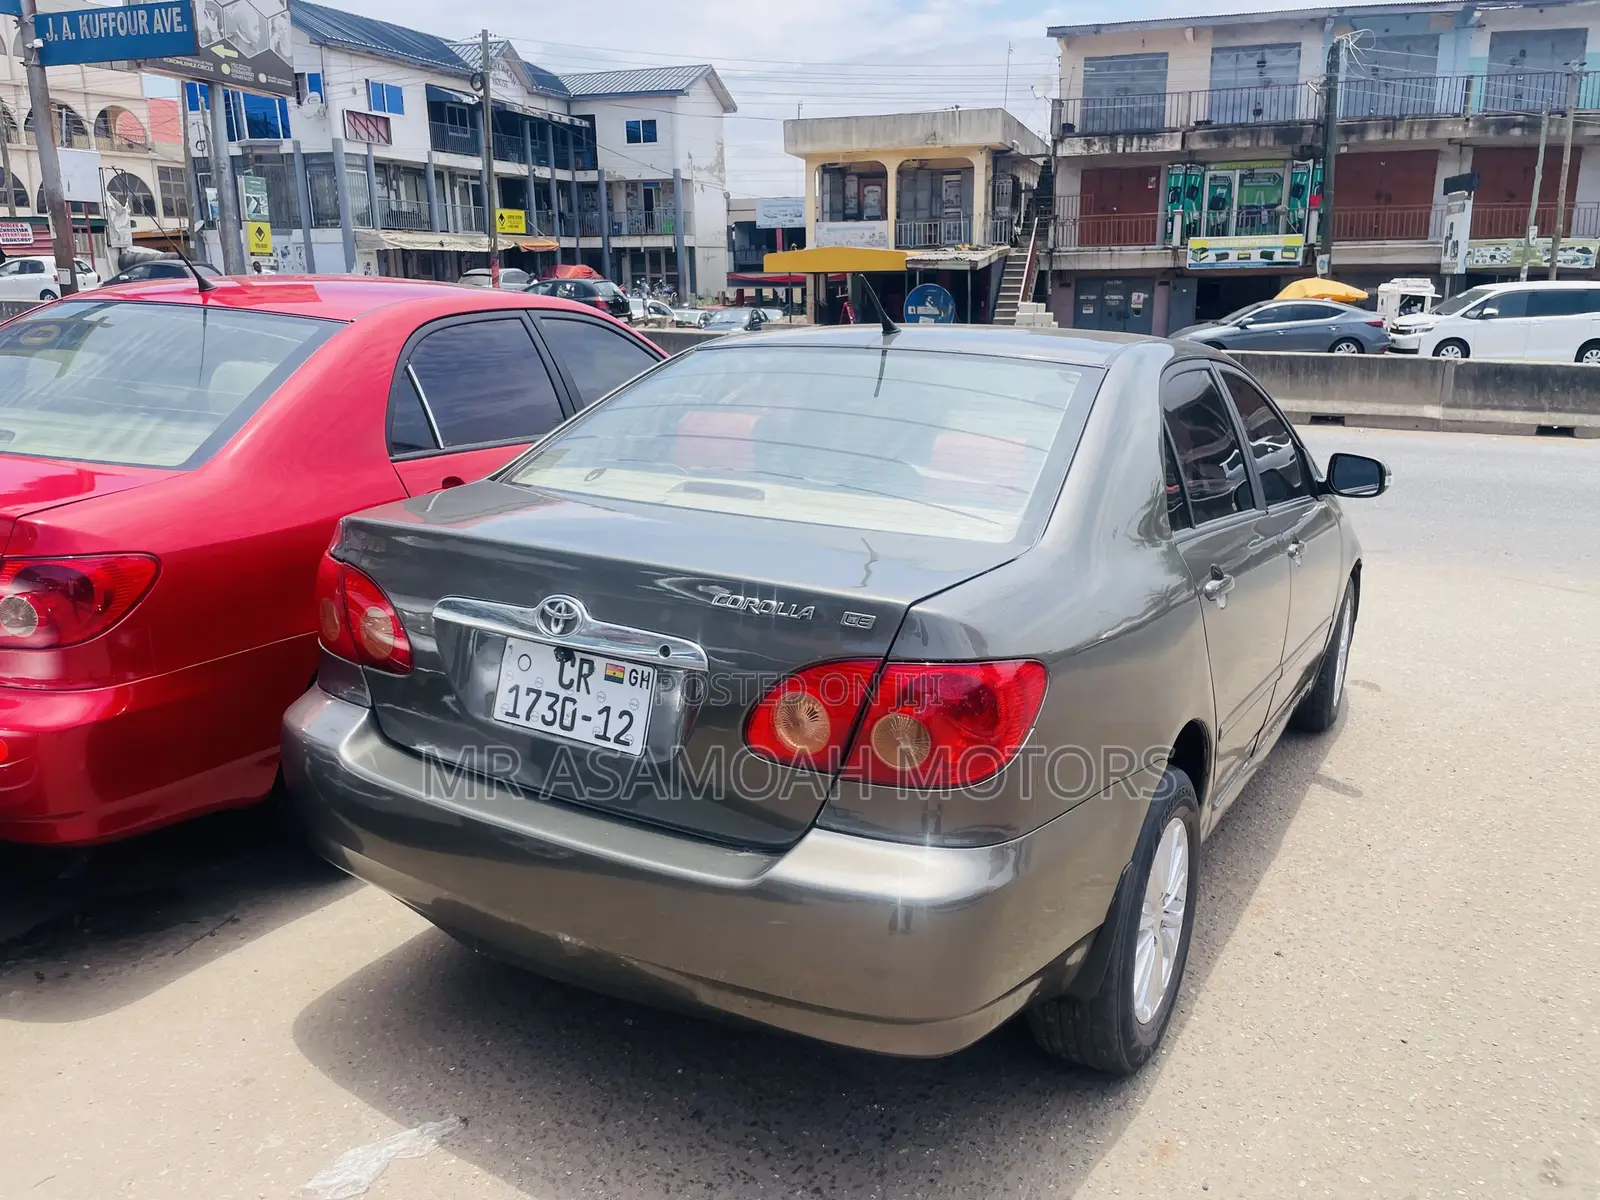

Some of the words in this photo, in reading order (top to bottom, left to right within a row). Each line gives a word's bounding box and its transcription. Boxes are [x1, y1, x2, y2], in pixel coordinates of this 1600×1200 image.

[46, 17, 58, 42] J.
[62, 16, 76, 41] A.
[79, 9, 149, 39] KUFFOUR
[153, 7, 188, 34] AVE.
[711, 593, 816, 621] COROLLA
[557, 654, 595, 695] CR
[628, 668, 651, 690] GH
[504, 683, 634, 747] 1730-12
